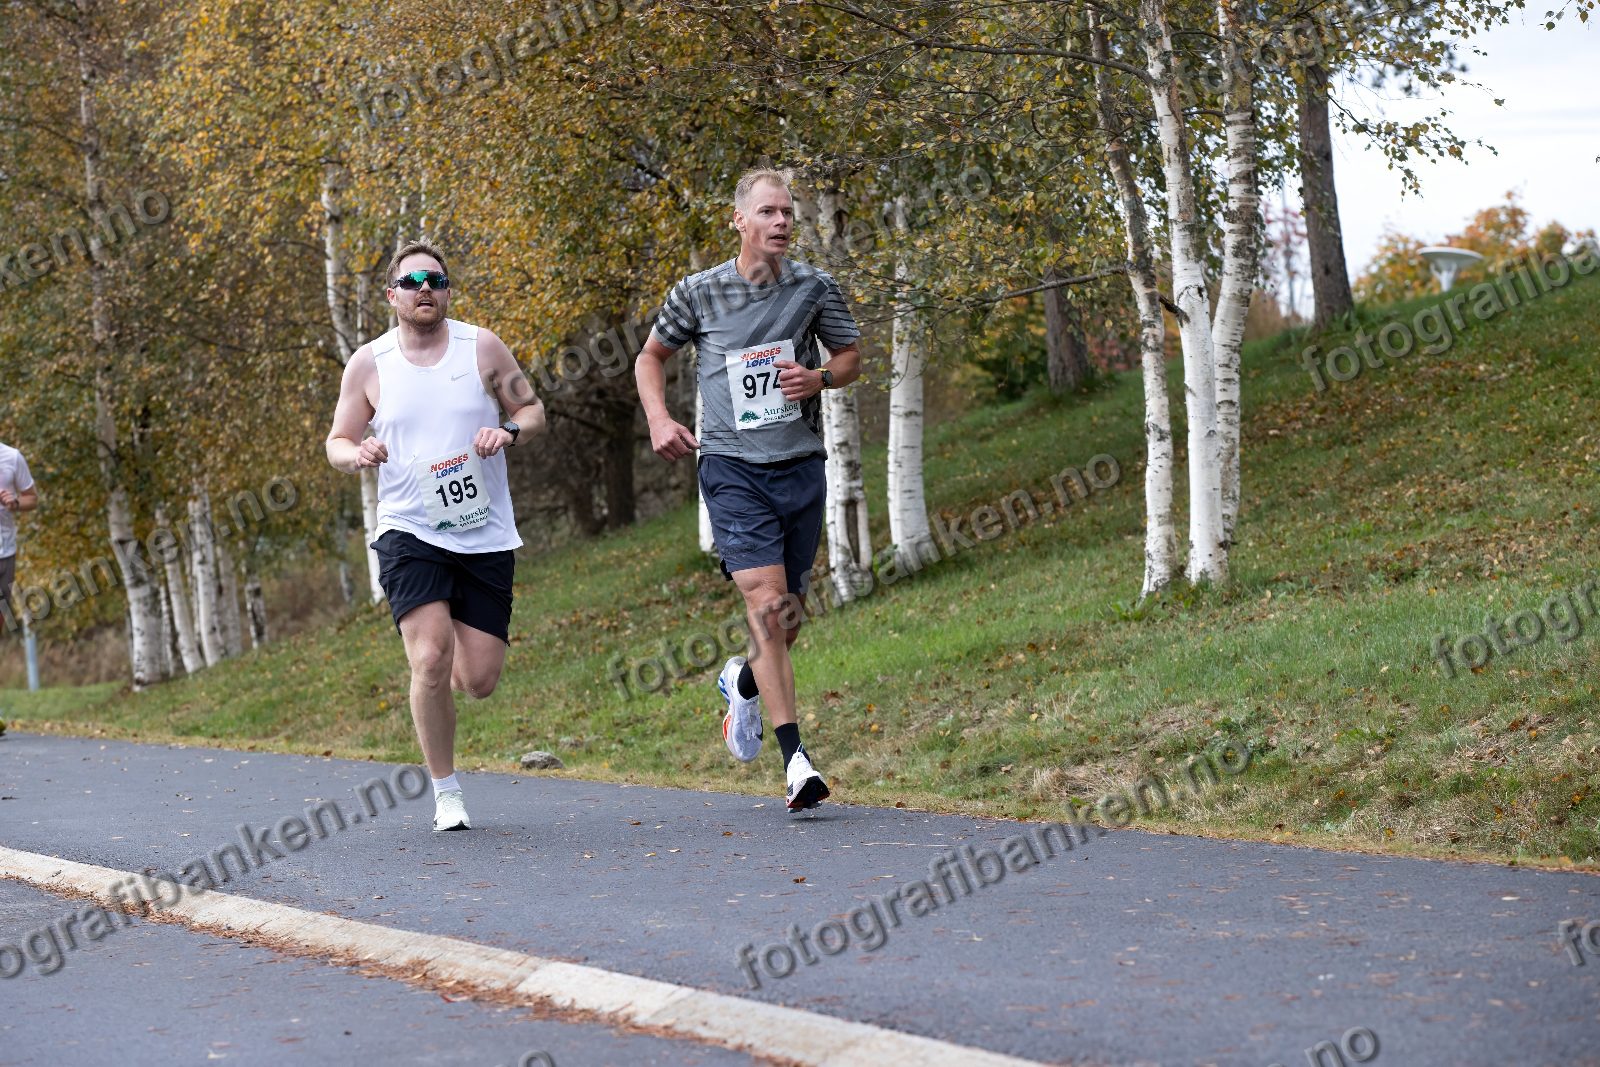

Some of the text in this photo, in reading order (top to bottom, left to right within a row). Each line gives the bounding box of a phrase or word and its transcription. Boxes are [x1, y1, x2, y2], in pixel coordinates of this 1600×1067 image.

[741, 347, 781, 361] NORGES
[746, 356, 775, 368] LØPET
[764, 402, 799, 416] Aurskog
[430, 453, 469, 473] NORGES
[436, 463, 465, 479] LØPET
[435, 475, 478, 508] 195
